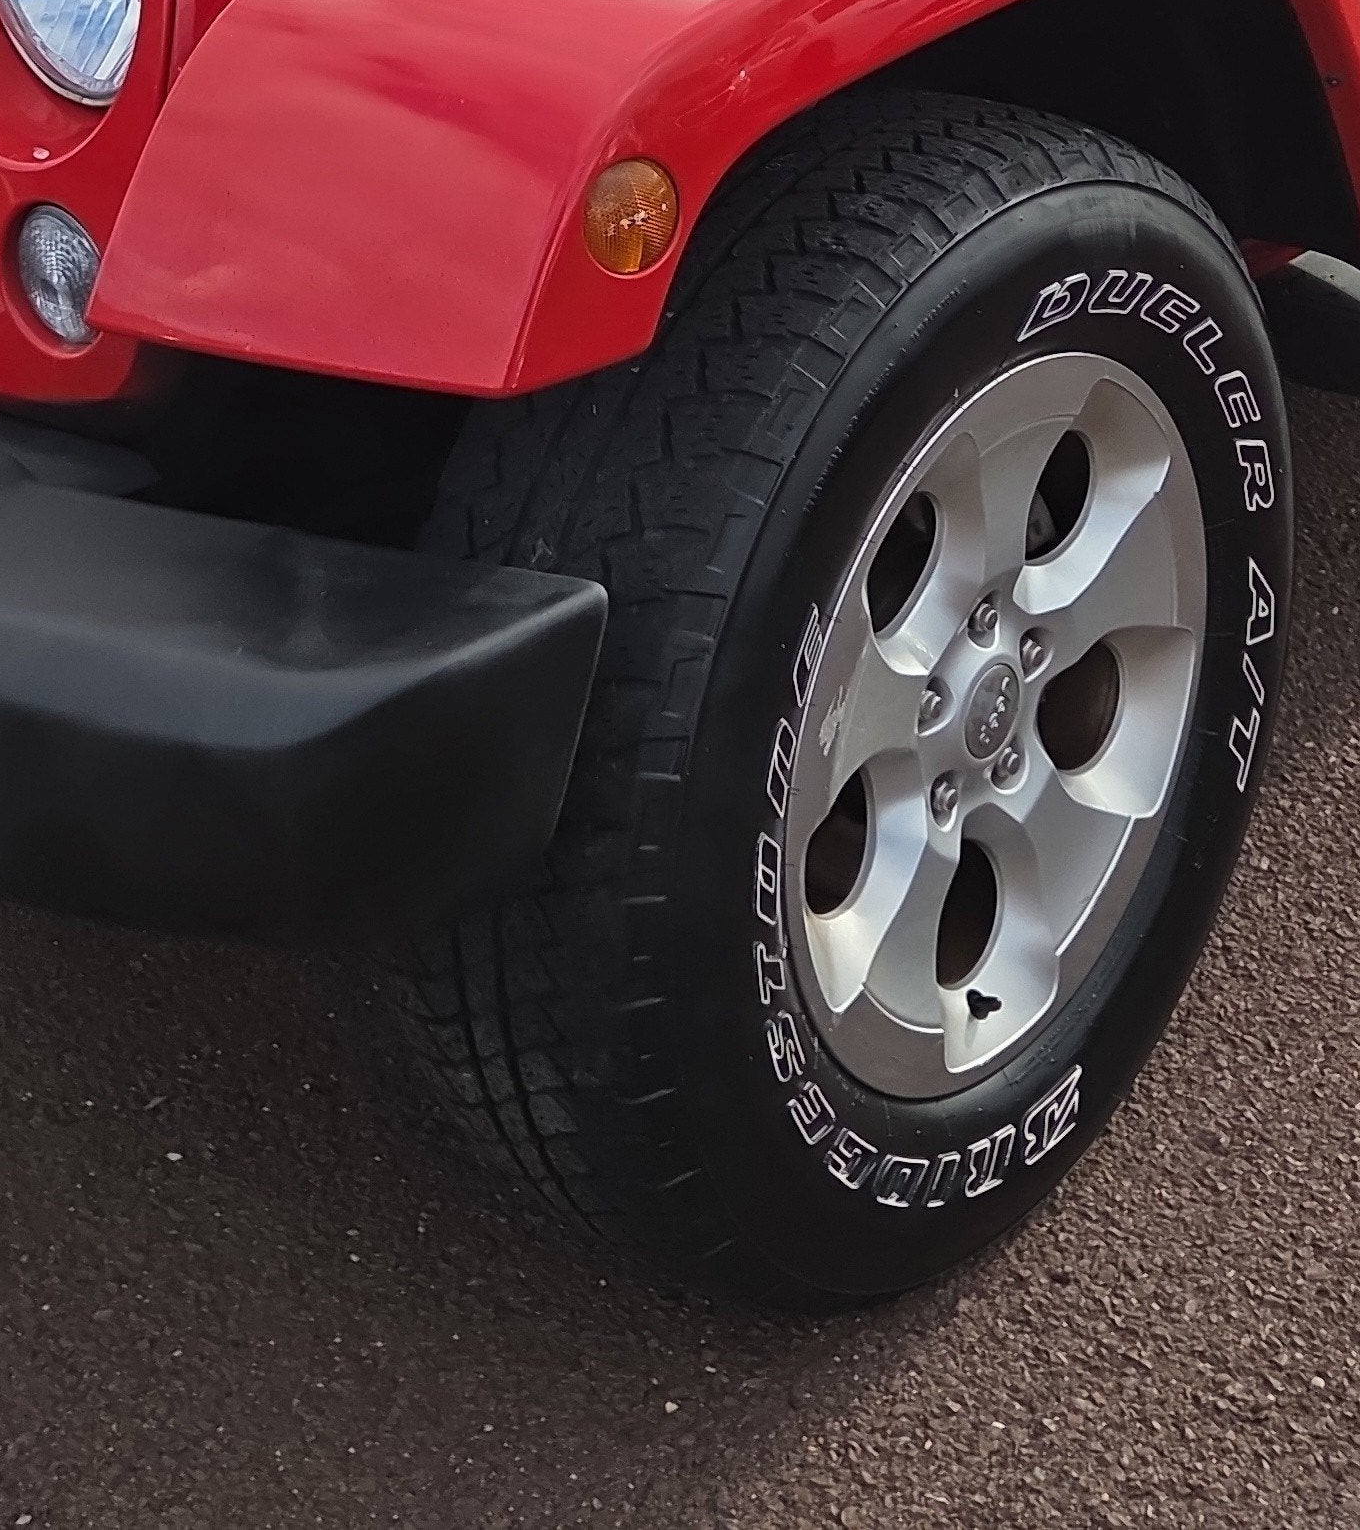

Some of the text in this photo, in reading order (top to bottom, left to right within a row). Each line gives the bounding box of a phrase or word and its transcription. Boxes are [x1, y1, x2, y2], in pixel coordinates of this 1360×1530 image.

[1016, 269, 1276, 513] DUELER
[1228, 555, 1277, 794] A/T
[753, 601, 1083, 1209] BRIDGESTONE
